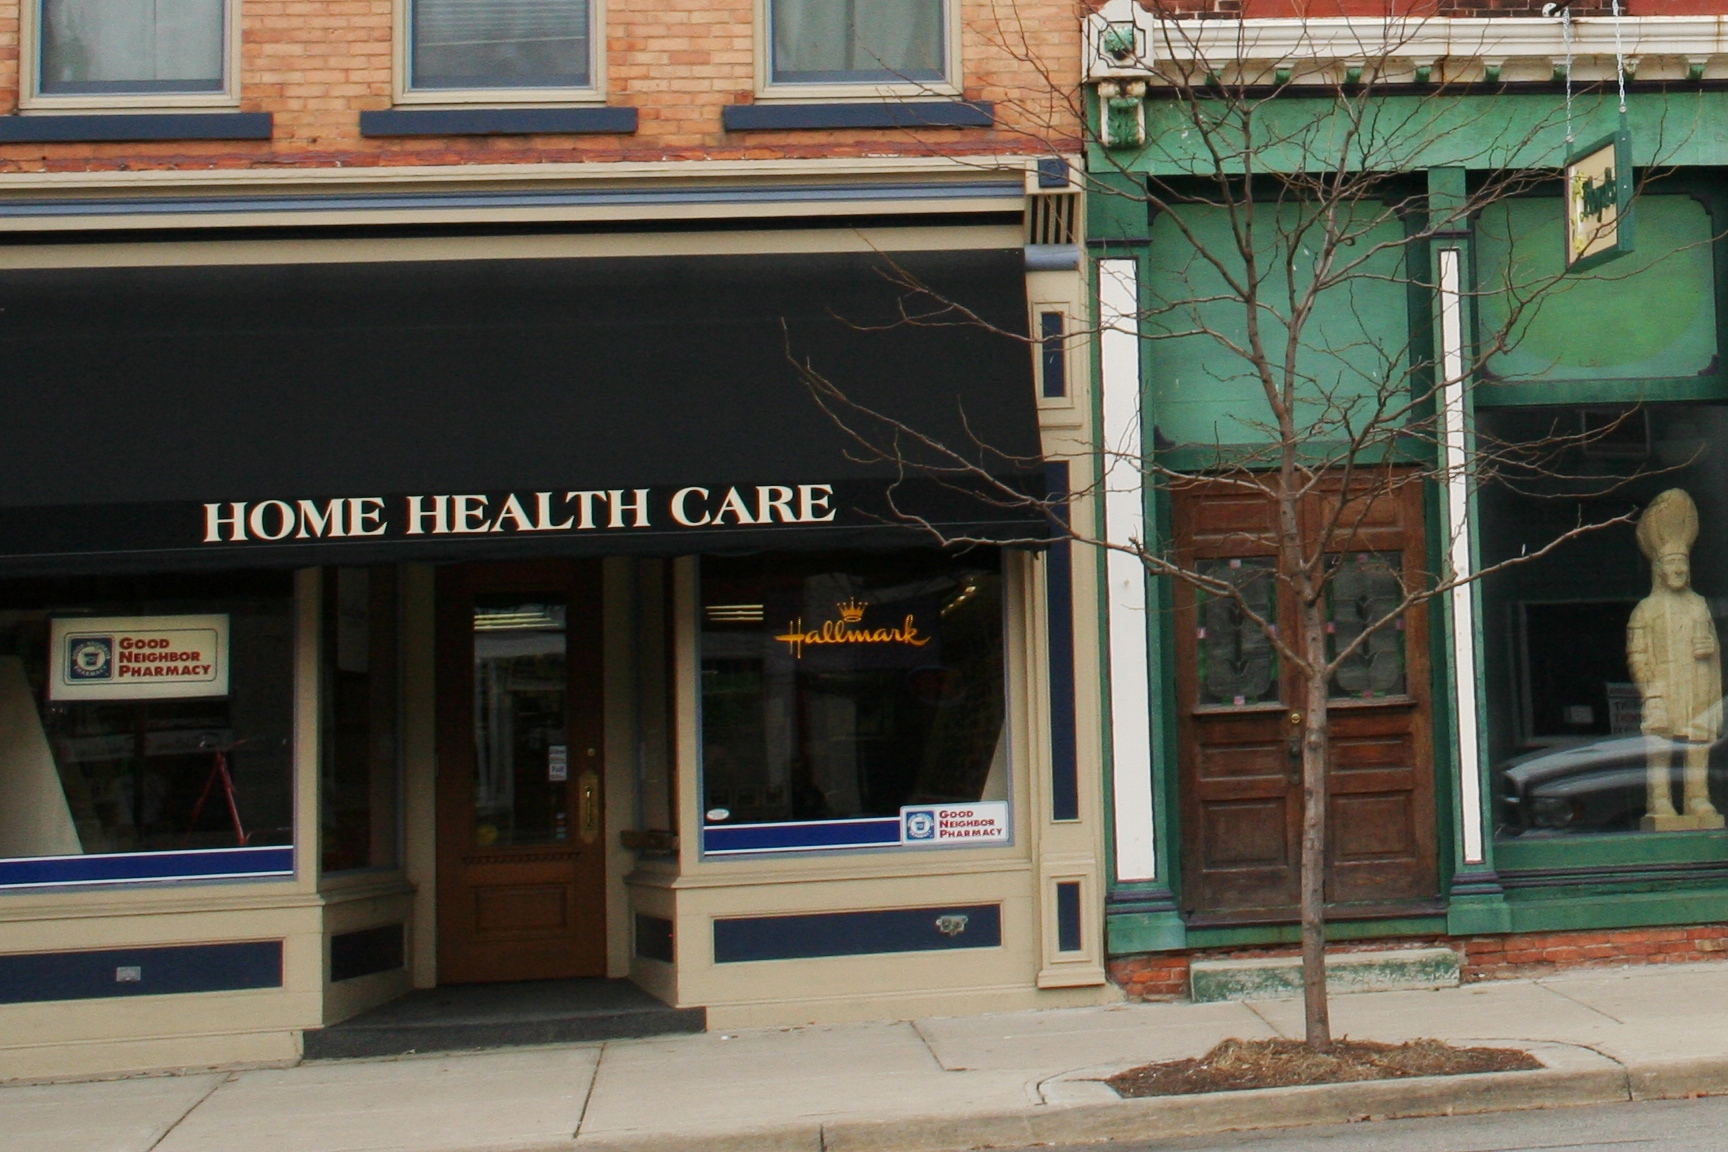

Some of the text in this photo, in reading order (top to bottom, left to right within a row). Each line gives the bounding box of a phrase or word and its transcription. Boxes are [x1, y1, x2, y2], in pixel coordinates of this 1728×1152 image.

[203, 484, 837, 543] HOME HEALTH CARE
[773, 613, 932, 659] Hallmark
[118, 637, 170, 649] GOOD
[118, 651, 201, 663] NEIGHBOR
[118, 664, 212, 678] PHARMACY
[939, 810, 974, 819] GOOD
[939, 819, 995, 829] NEIGHBOR
[939, 828, 1003, 839] PHARMACY
